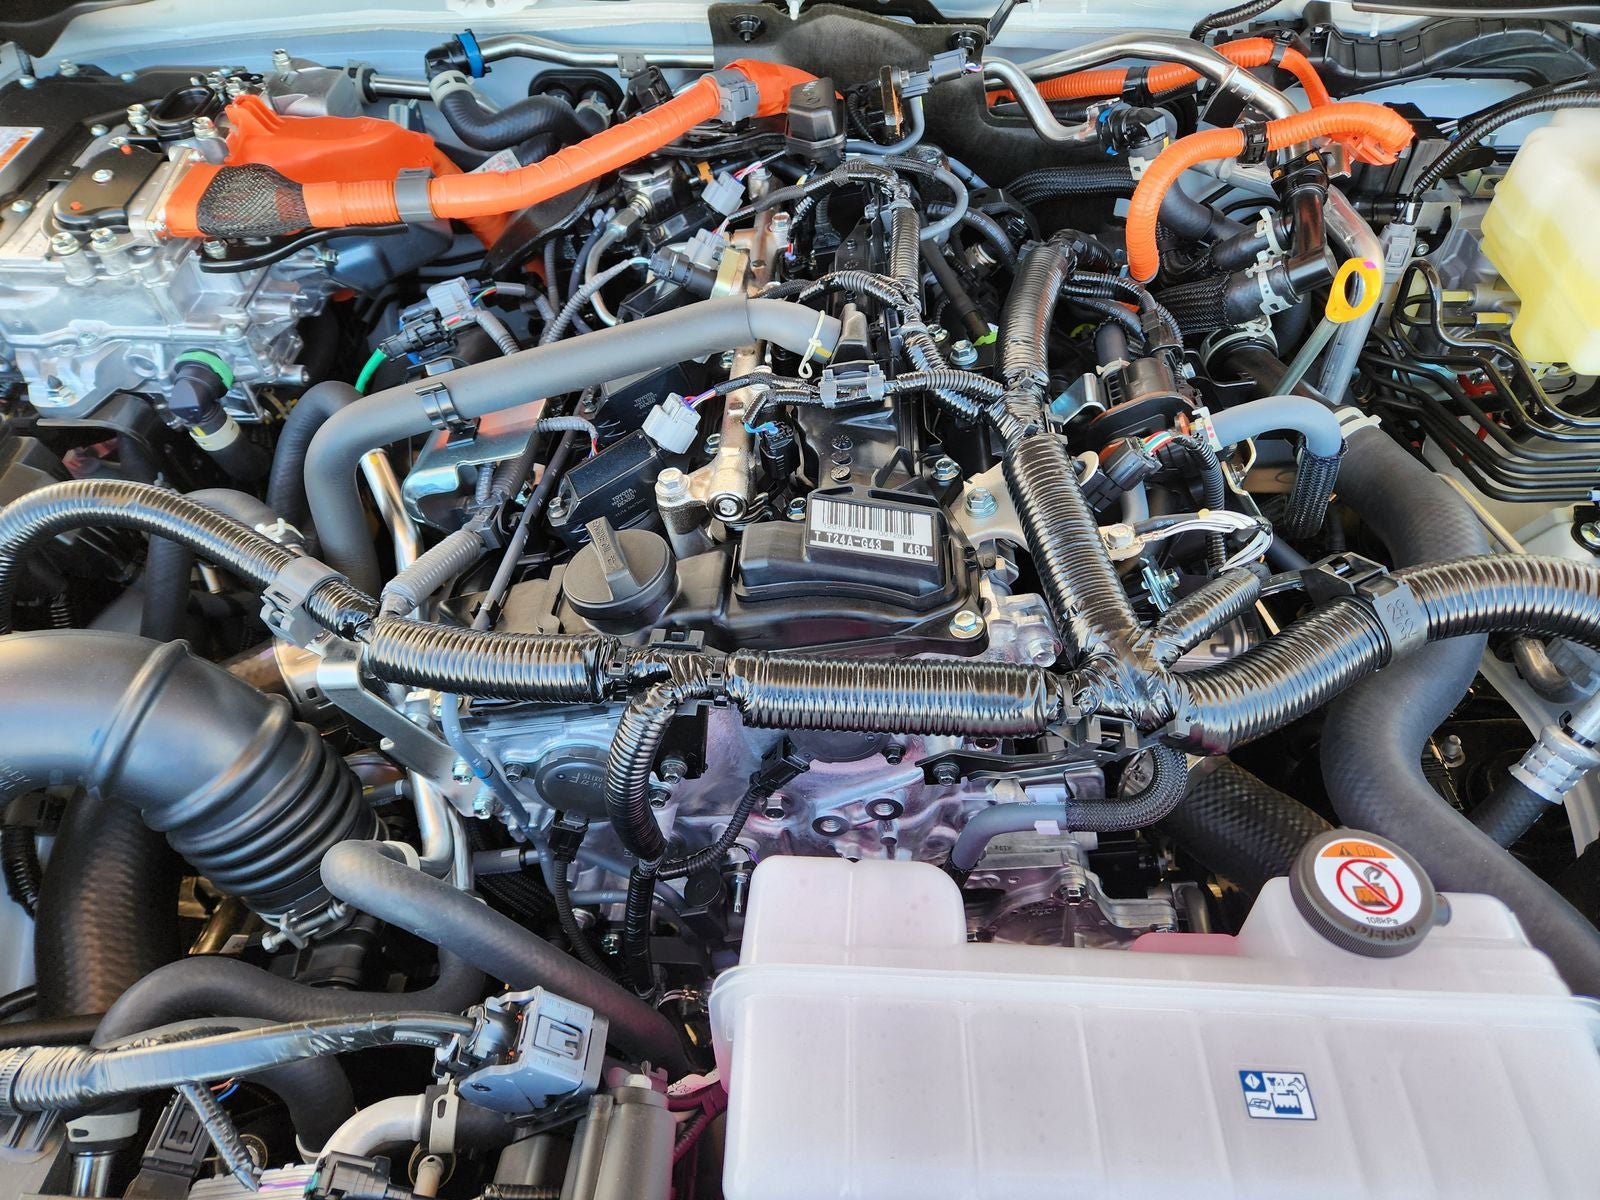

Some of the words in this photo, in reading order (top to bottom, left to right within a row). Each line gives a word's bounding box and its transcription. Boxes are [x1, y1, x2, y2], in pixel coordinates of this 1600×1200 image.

[611, 487, 633, 502] TOYOTA
[826, 531, 882, 550] T24A-G43
[907, 544, 928, 557] 460
[1366, 916, 1399, 926] 108kPa
